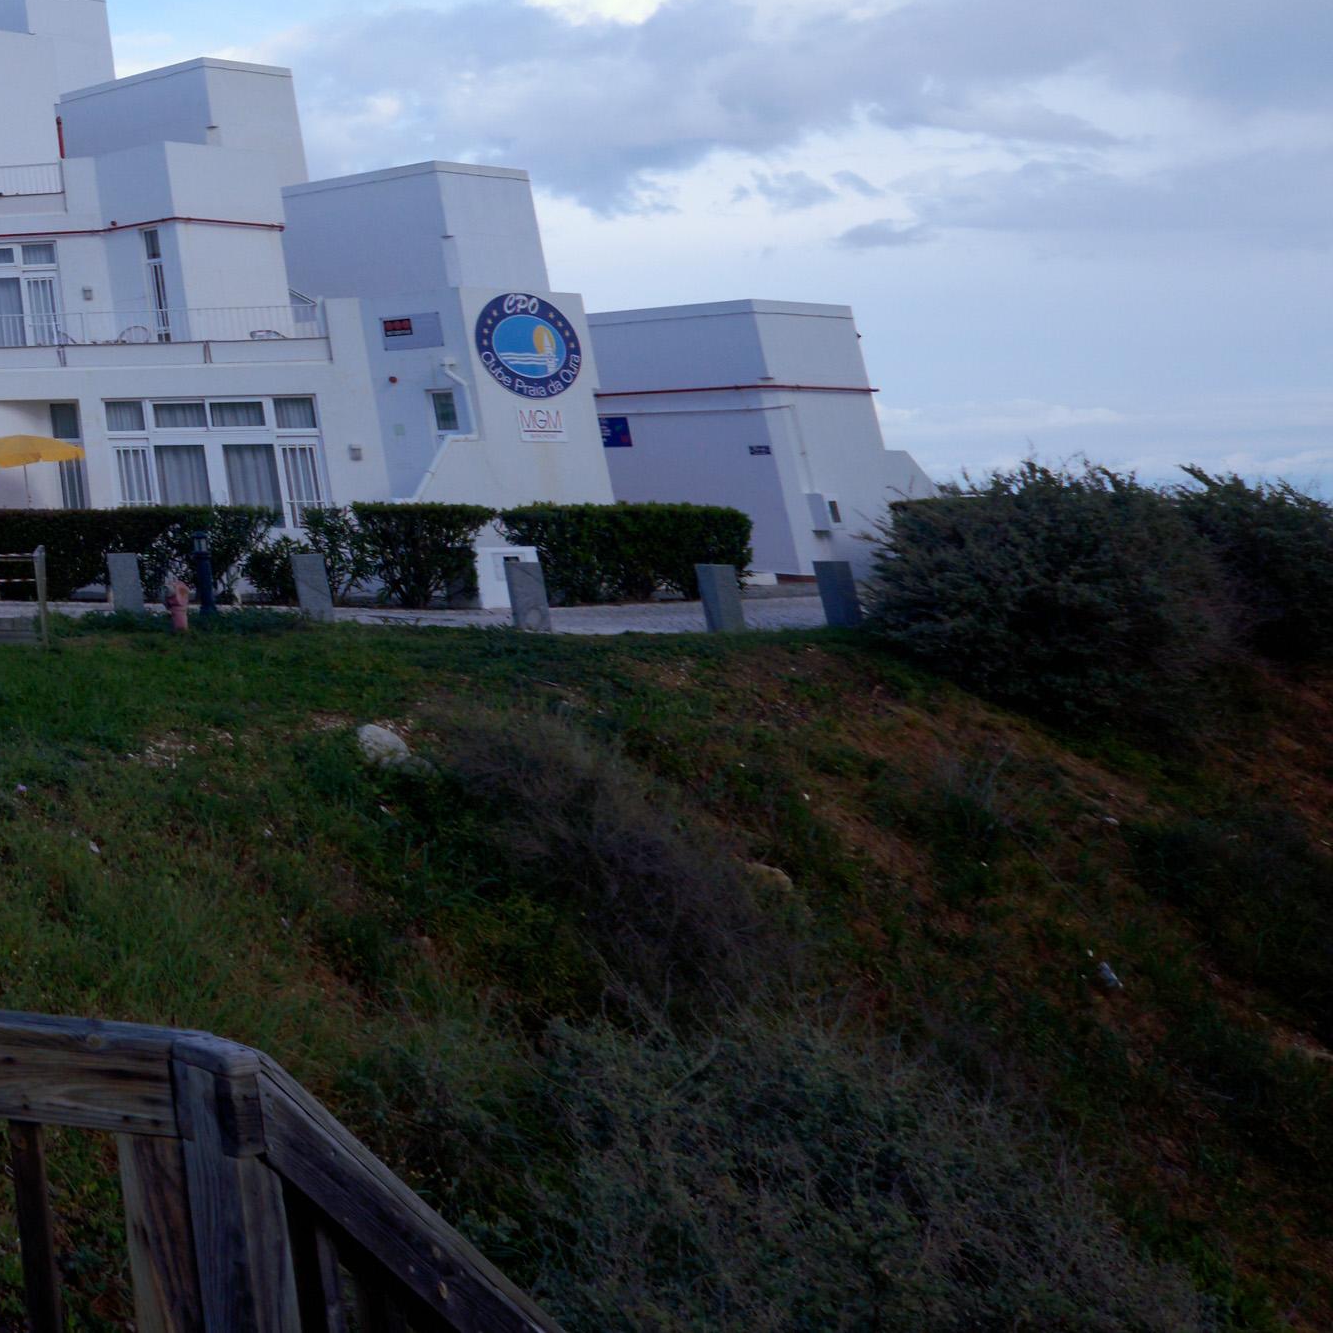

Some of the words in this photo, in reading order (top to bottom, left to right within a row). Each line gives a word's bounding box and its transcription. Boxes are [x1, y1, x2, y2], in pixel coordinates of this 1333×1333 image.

[503, 294, 539, 314] CPO
[481, 351, 512, 386] Clube
[514, 378, 546, 396] Praia
[548, 379, 564, 394] da
[559, 354, 580, 383] Oura
[518, 409, 563, 429] MGM
